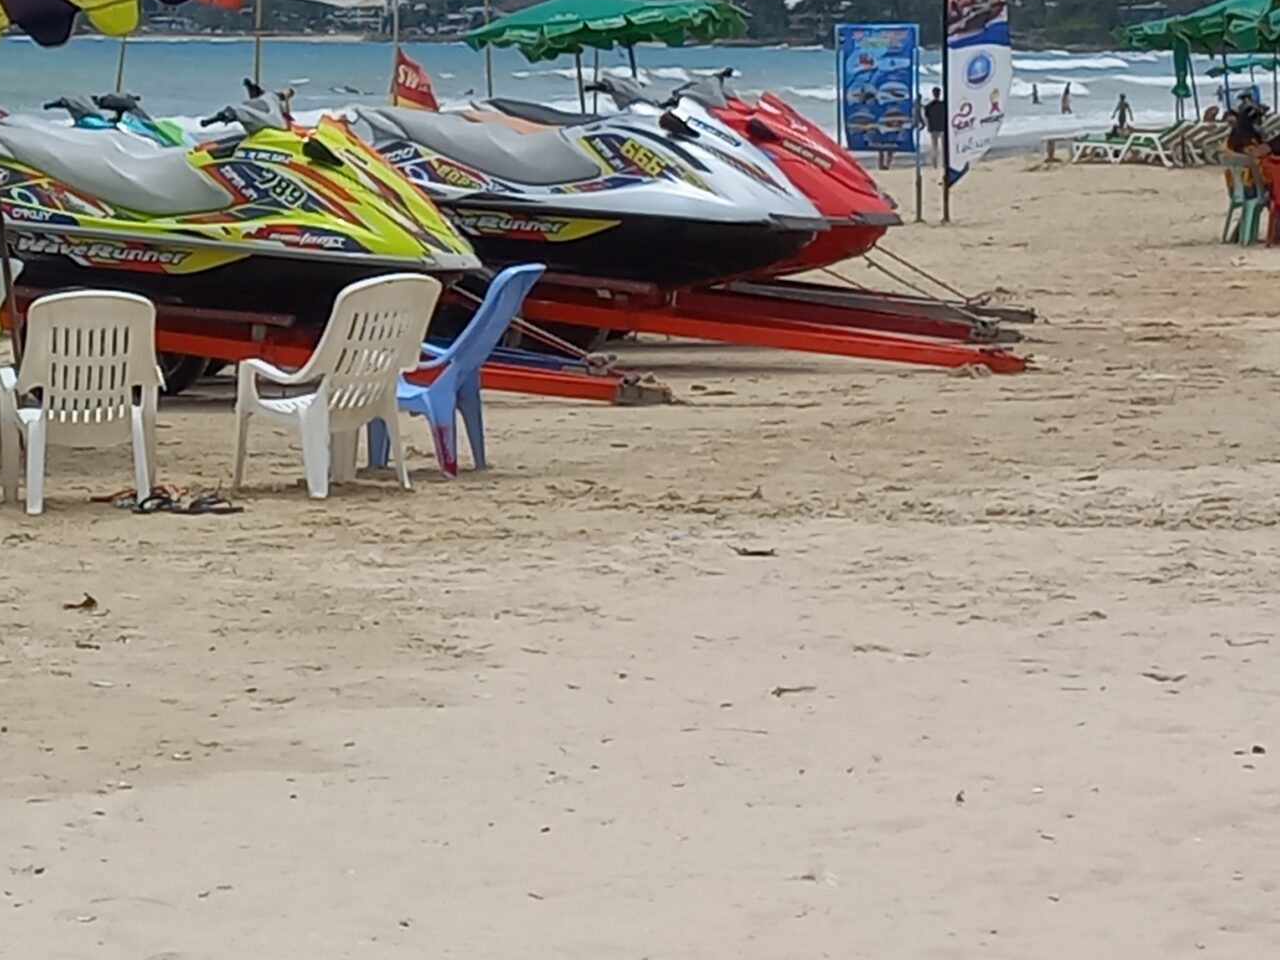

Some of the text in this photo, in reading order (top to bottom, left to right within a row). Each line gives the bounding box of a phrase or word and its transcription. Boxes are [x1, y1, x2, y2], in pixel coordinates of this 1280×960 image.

[621, 138, 666, 176] 666
[254, 167, 307, 208] 789
[17, 234, 188, 265] WaveRunner
